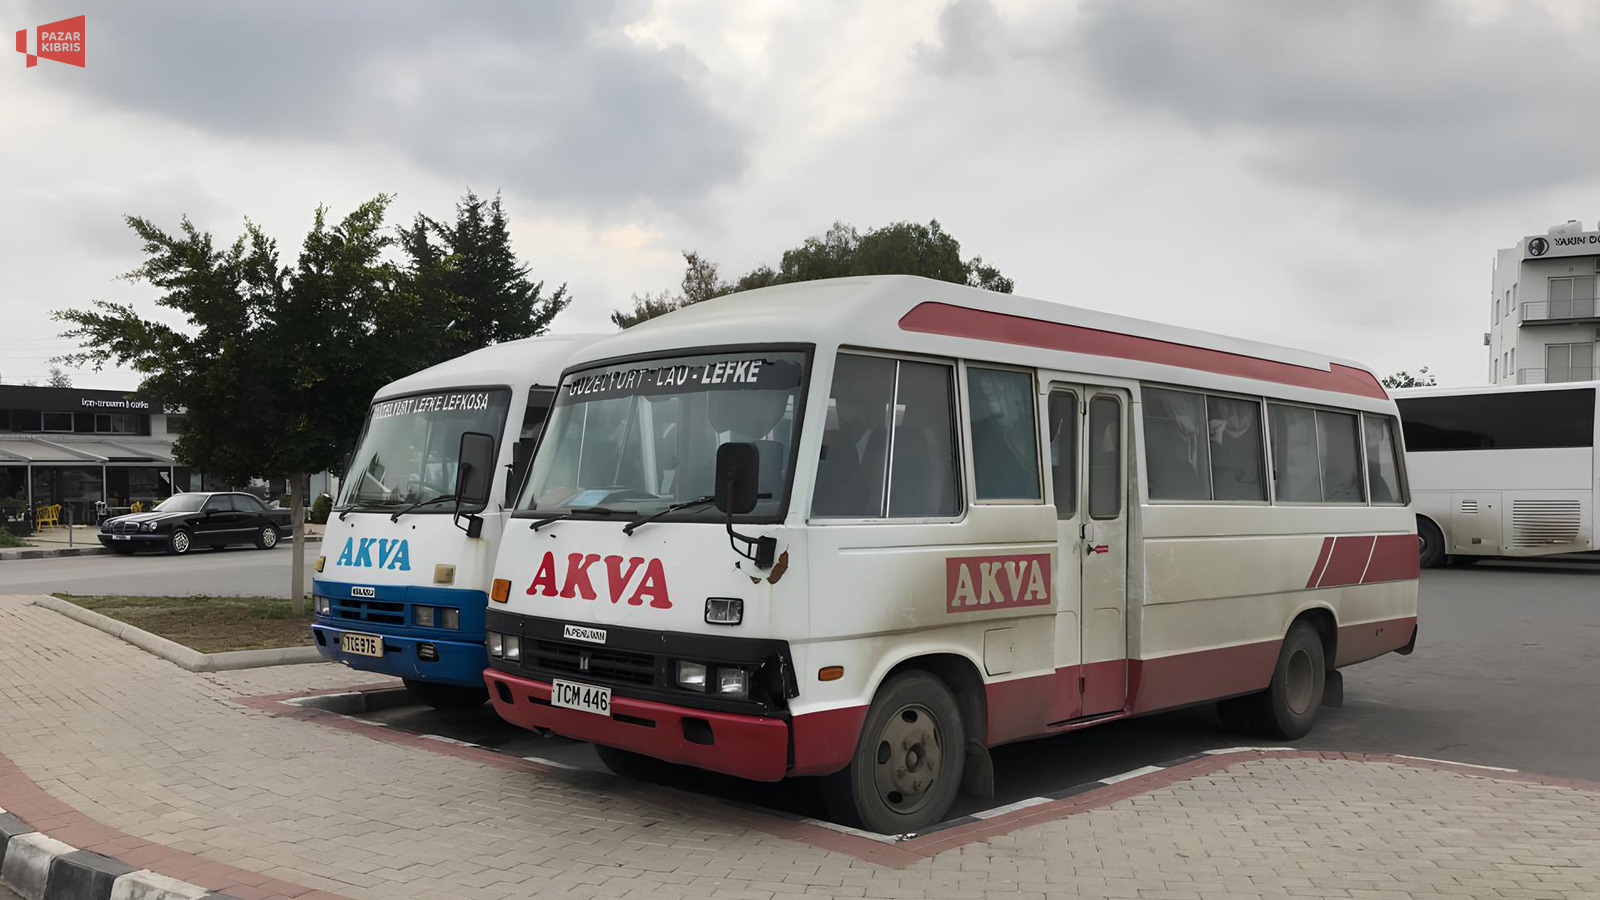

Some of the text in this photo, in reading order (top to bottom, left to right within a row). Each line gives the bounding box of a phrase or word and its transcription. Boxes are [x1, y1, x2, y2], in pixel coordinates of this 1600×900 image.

[701, 360, 762, 384] LEFKE
[336, 536, 411, 571] AKVA
[526, 550, 673, 609] AKVA
[951, 559, 1048, 608] AKVA
[556, 683, 608, 711] TCM 446
